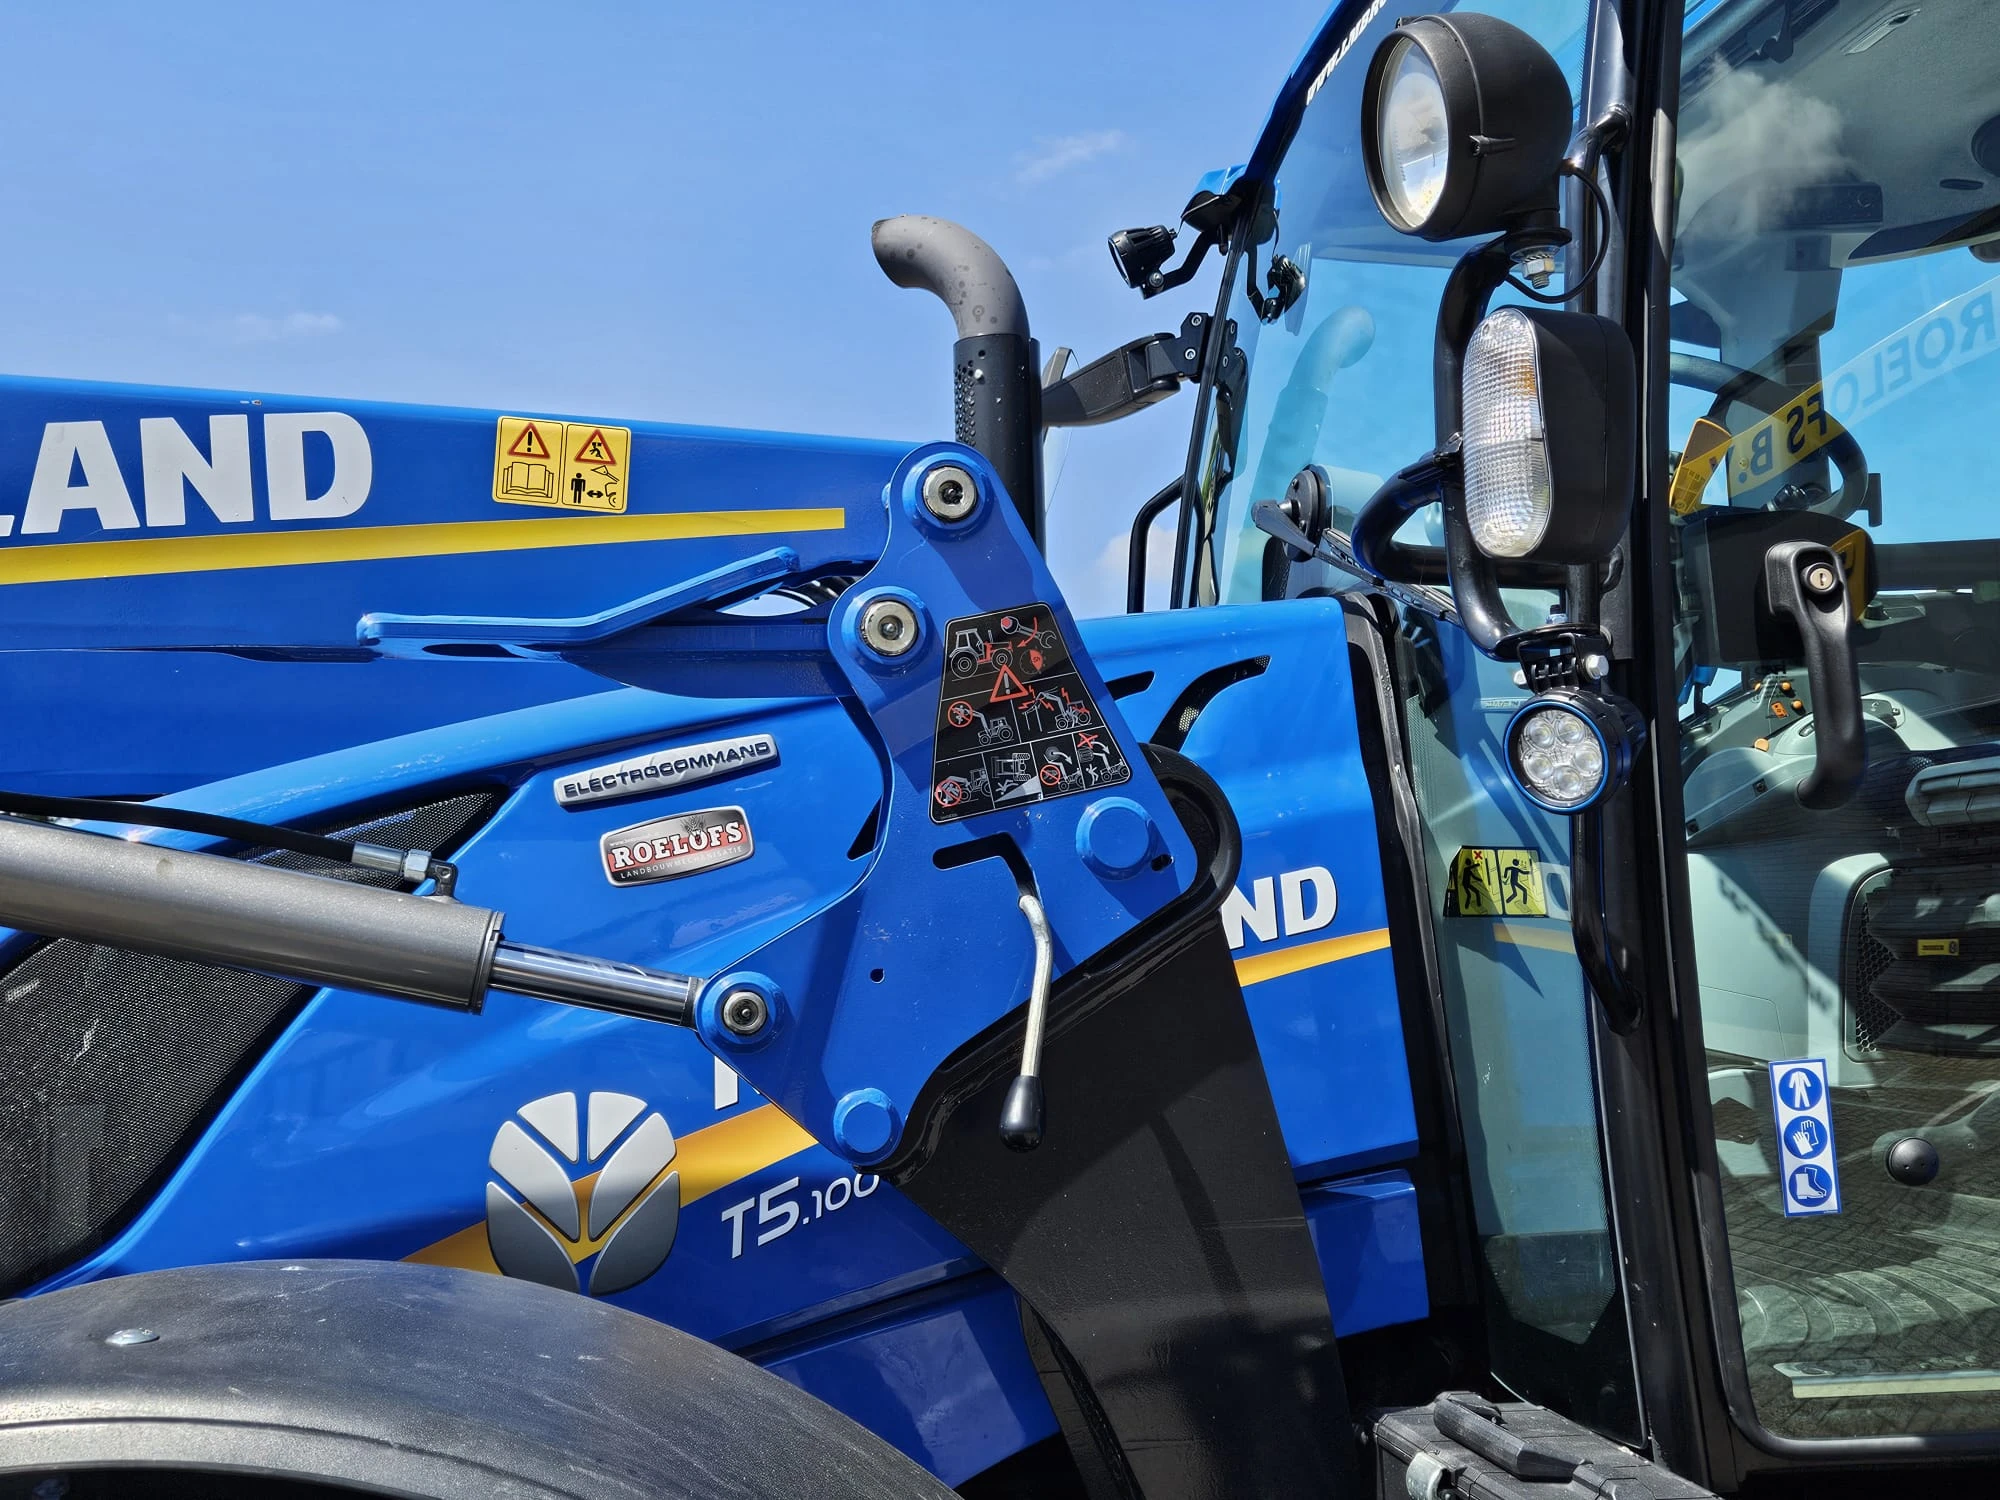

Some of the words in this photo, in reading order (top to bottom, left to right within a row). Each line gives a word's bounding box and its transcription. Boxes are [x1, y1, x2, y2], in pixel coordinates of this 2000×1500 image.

[0, 412, 373, 537] AND
[563, 741, 771, 798] ELECTROCOMMAND
[612, 821, 743, 868] ROELOFS
[1219, 866, 1338, 950] ND
[721, 1176, 880, 1259] T5.100
